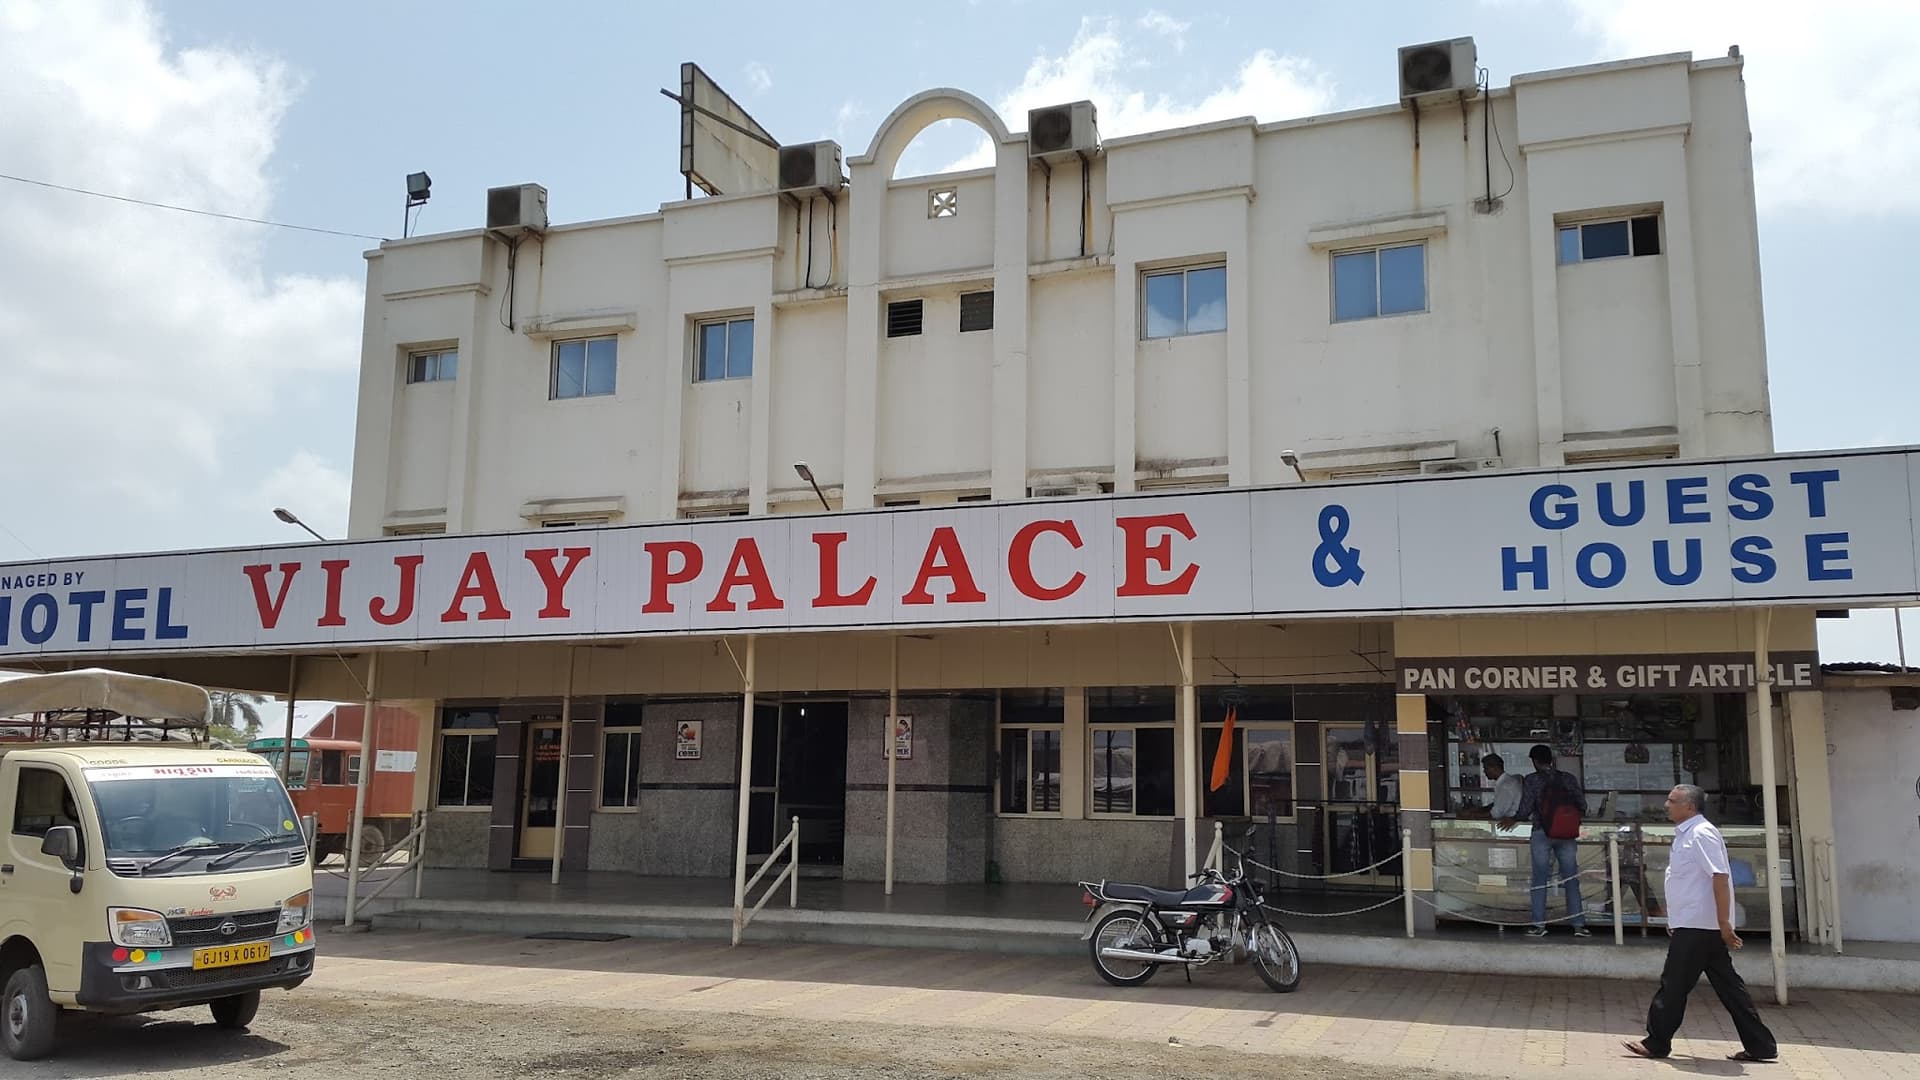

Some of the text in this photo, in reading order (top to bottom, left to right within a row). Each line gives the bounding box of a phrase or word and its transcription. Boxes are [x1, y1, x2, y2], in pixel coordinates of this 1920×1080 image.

[1530, 470, 1839, 529] GUEST
[63, 571, 85, 586] BY
[244, 505, 1364, 628] VIJAY PALACE &
[1502, 533, 1852, 591] HOUSE
[1404, 668, 1456, 689] PAN
[1464, 666, 1578, 689] CORNER
[1587, 665, 1607, 688] &
[1616, 664, 1681, 688] GIFT
[203, 945, 268, 965] GJ19 X 0617
